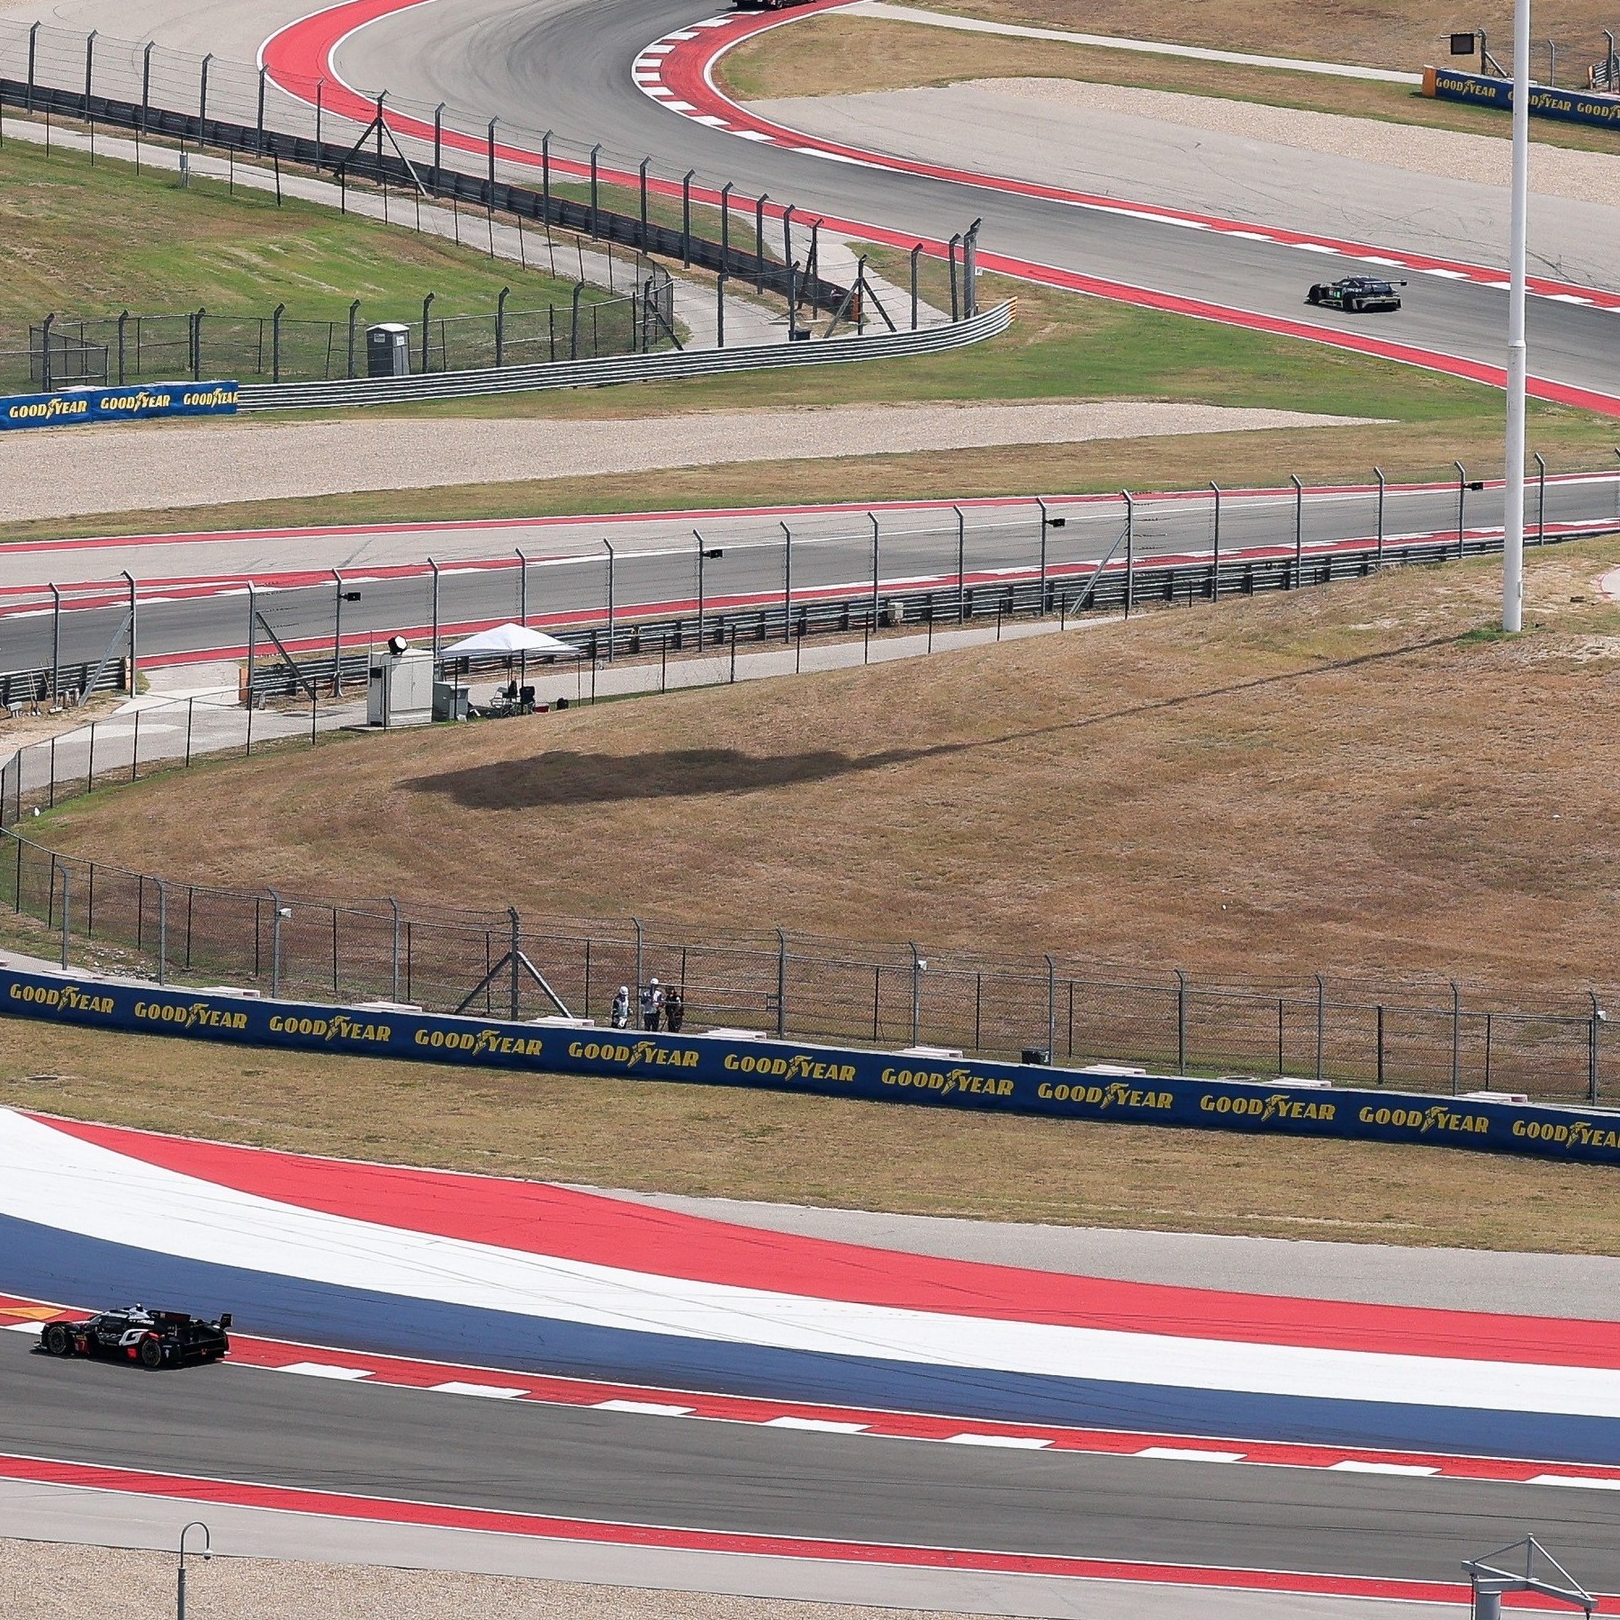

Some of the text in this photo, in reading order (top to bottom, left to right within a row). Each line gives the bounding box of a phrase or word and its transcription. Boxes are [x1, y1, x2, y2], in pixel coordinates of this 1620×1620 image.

[1435, 77, 1497, 98] GOODYEAR
[1507, 91, 1572, 111] GDYEAR
[9, 398, 88, 419] GOODYEAR
[100, 391, 172, 412] GOODYEAR
[10, 984, 114, 1014] GOODYEAR
[134, 1002, 248, 1029] GOODYEAR
[269, 1016, 391, 1041] GOODYEAR
[414, 1029, 543, 1054] GOODYEAR
[568, 1041, 699, 1067] GOODYEAR
[724, 1054, 856, 1082] GOODYEAR
[881, 1068, 1014, 1097] GOODYEAR
[1038, 1082, 1174, 1110] GOODYEAR
[1200, 1094, 1336, 1122] GOODYEAR
[1359, 1105, 1490, 1135] GOODYEAR
